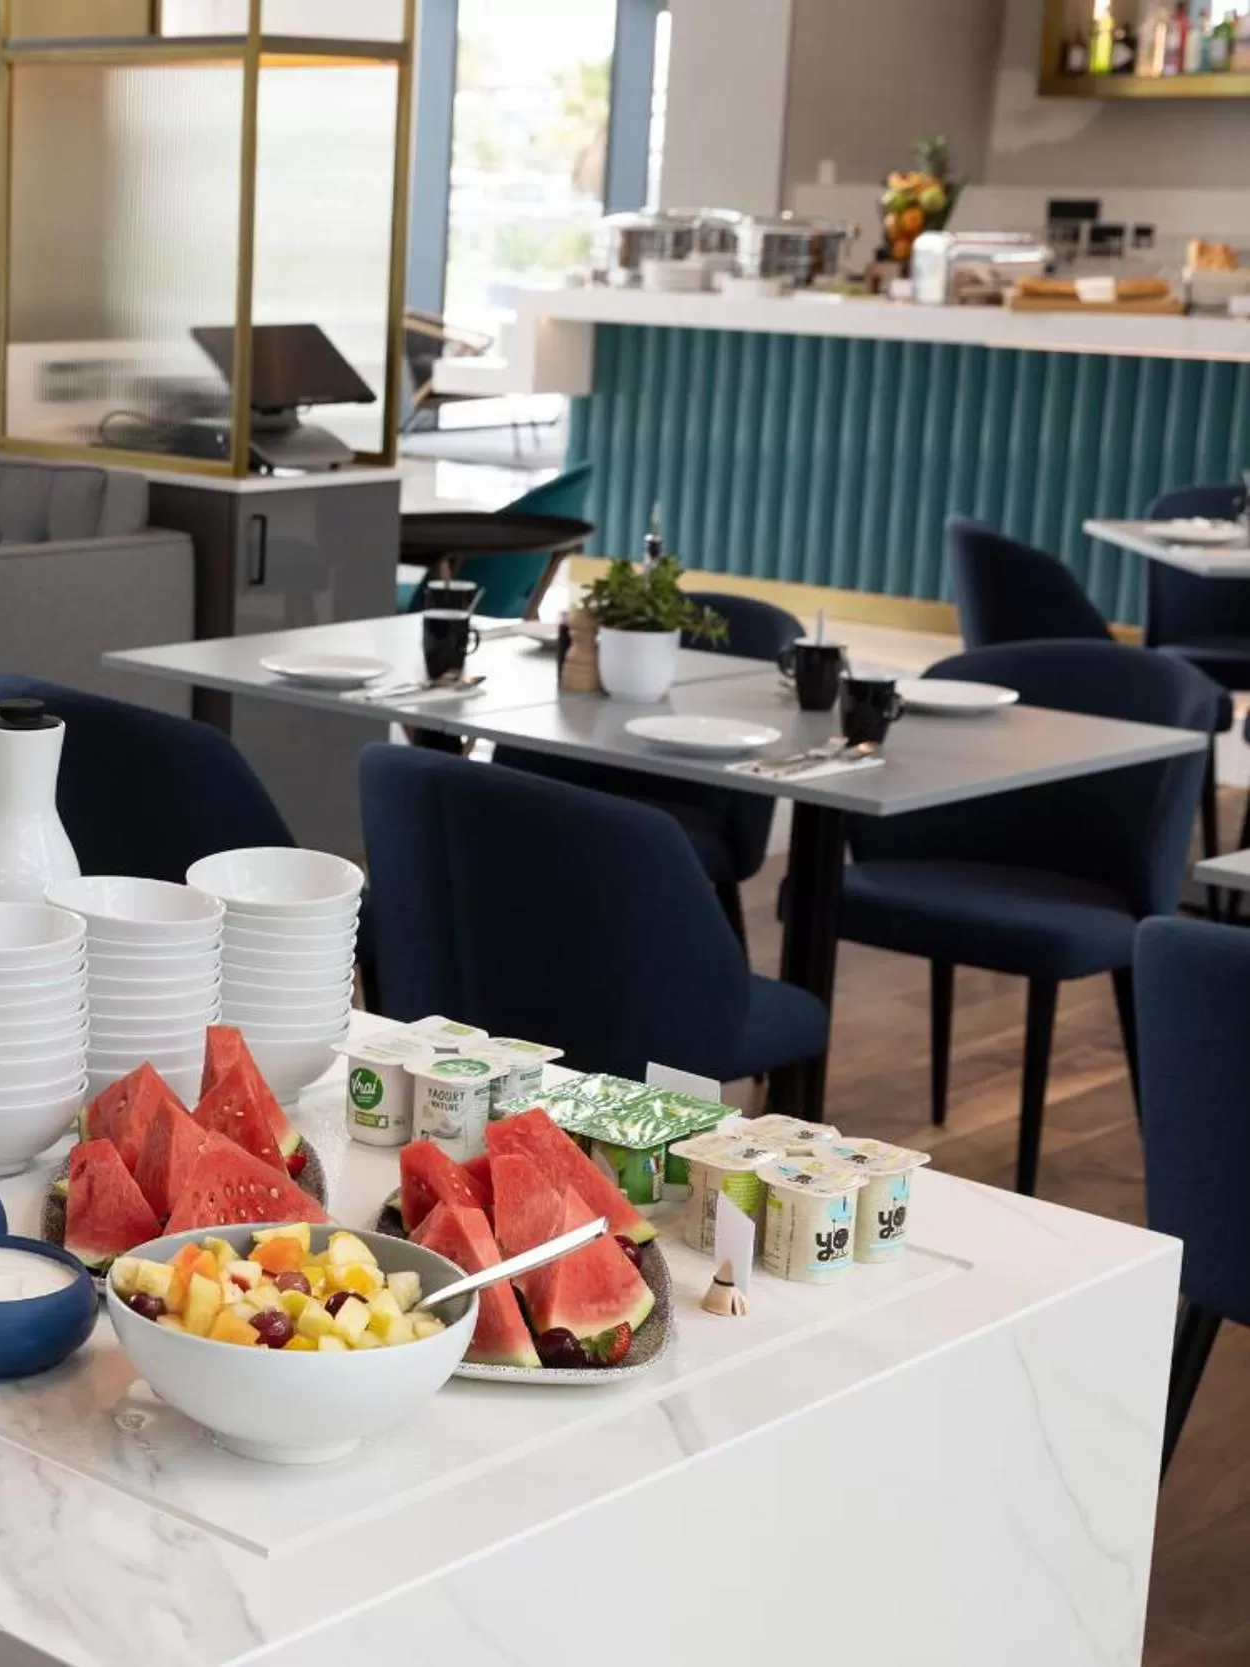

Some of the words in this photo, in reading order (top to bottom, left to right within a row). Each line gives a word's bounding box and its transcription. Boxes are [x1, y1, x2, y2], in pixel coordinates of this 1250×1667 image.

[350, 1070, 378, 1095] Vrai
[427, 1087, 466, 1101] YAOURT
[430, 1101, 460, 1112] NATURE
